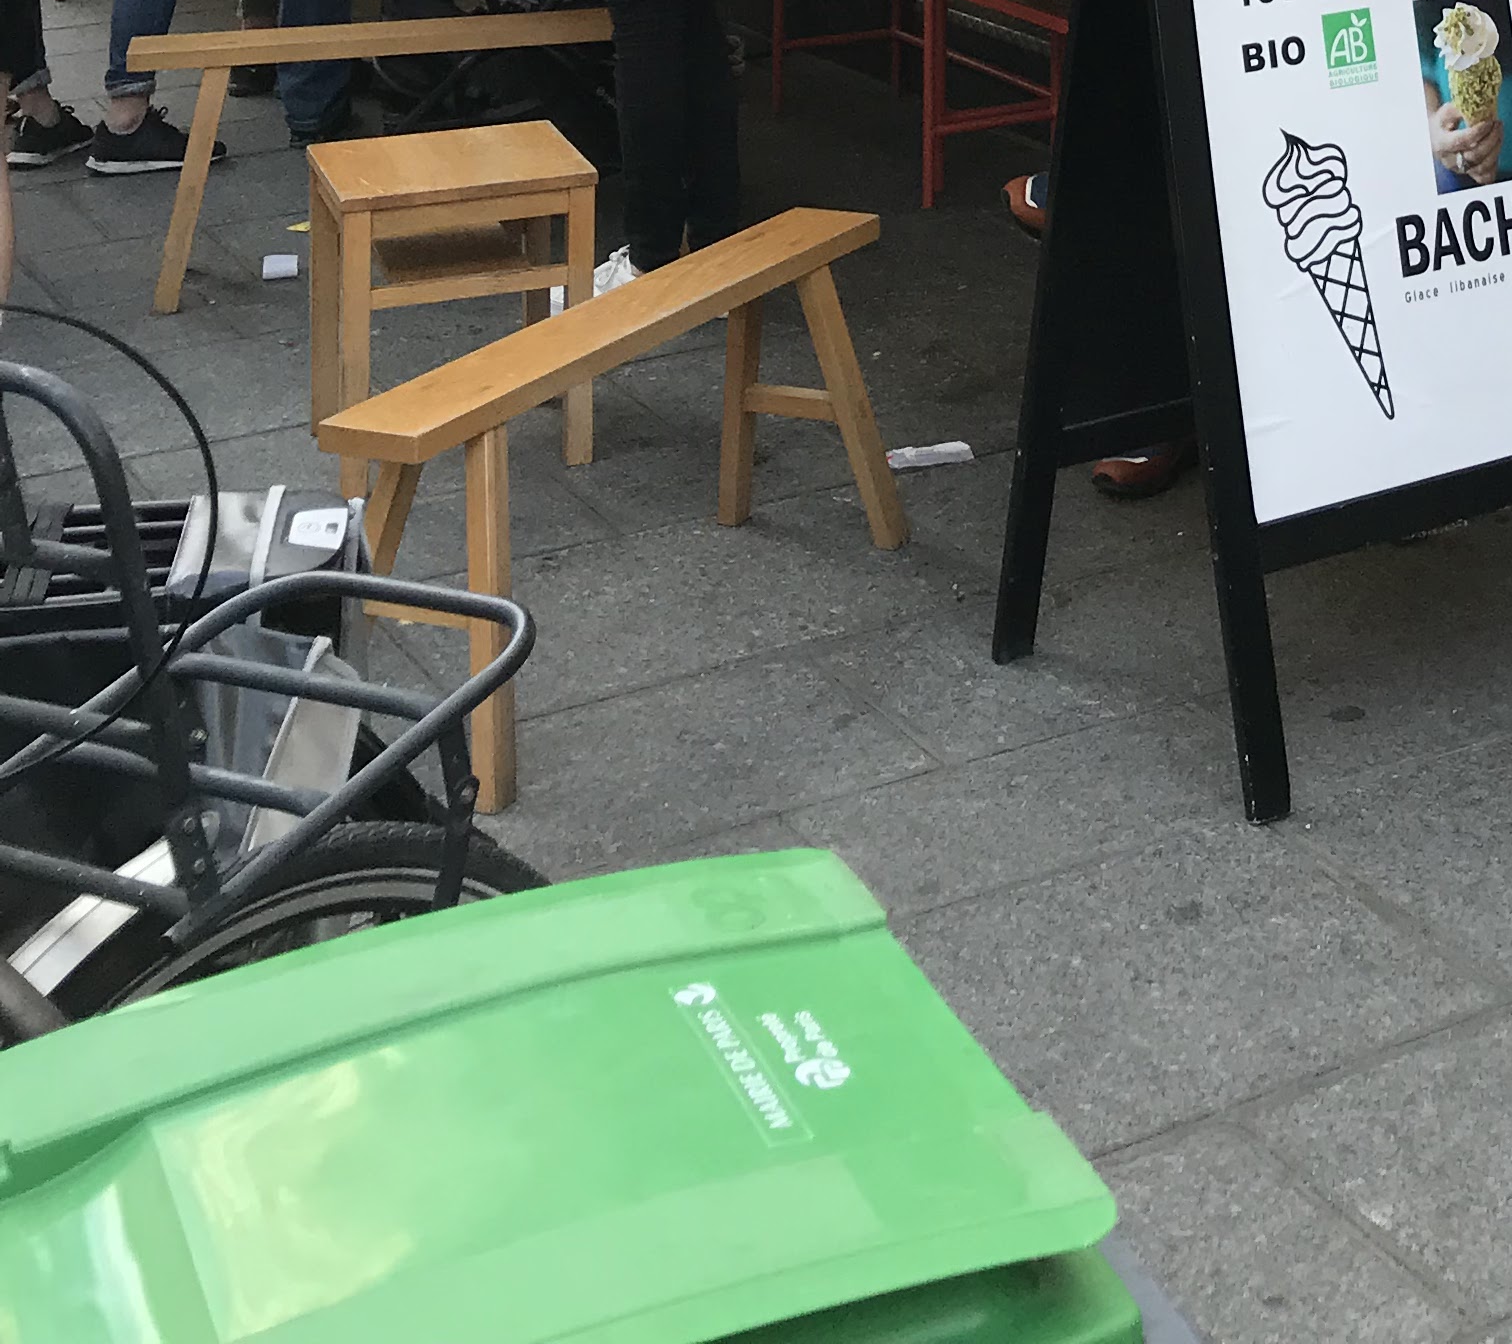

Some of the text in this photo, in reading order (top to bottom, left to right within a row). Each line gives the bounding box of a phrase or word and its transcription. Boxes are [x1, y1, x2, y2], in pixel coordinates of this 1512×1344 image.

[1242, 36, 1306, 73] BIO
[1330, 26, 1368, 66] AB
[1328, 63, 1377, 78] AGRICULTURE
[1329, 72, 1378, 87] BIOLOGIQUE
[1404, 286, 1439, 303] Glace
[1449, 271, 1505, 293] libanaise
